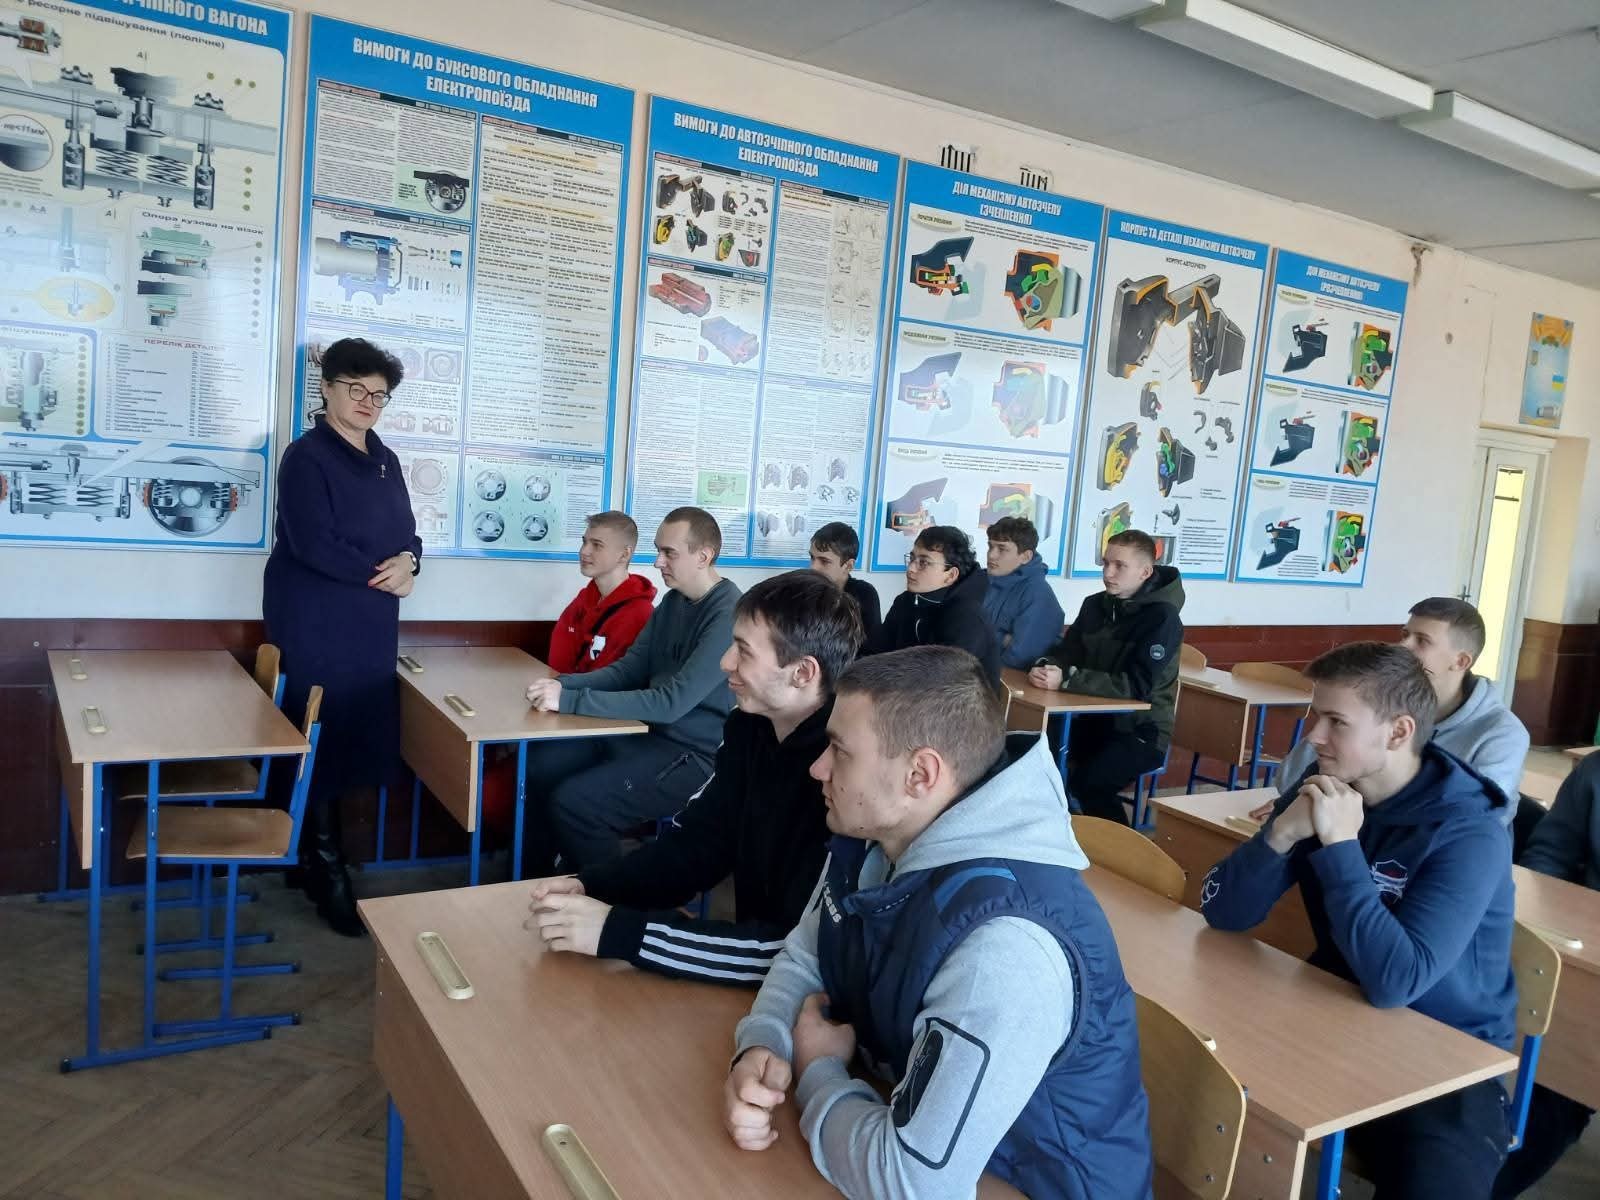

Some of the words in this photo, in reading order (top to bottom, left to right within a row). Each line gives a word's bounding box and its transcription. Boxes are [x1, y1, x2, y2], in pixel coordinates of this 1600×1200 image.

[84, 12, 168, 36] підвішування
[208, 7, 268, 36] ВАГОНА
[352, 36, 411, 65] ВИМОГИ
[412, 51, 433, 70] ДО
[435, 56, 511, 88] БУКСОВОГО
[513, 75, 599, 108] ОБЛАДНАННЯ
[426, 75, 531, 113] ЕЛЕКТРОПОЇЗДА
[674, 112, 719, 136] ВИМОГИ
[719, 123, 736, 140] ДО
[737, 127, 813, 158] АВТОЗЧІПНОГО
[814, 146, 879, 173] ОБЛАДНАННЯ
[738, 145, 819, 178] ЕЛЕКТРОПОЇЗДА
[952, 180, 969, 196] ДІЯ
[969, 185, 1020, 206] МЕХАНІЗМУ
[1017, 195, 1062, 216] АВТОЗЧЕПУ
[141, 211, 178, 222] Опора
